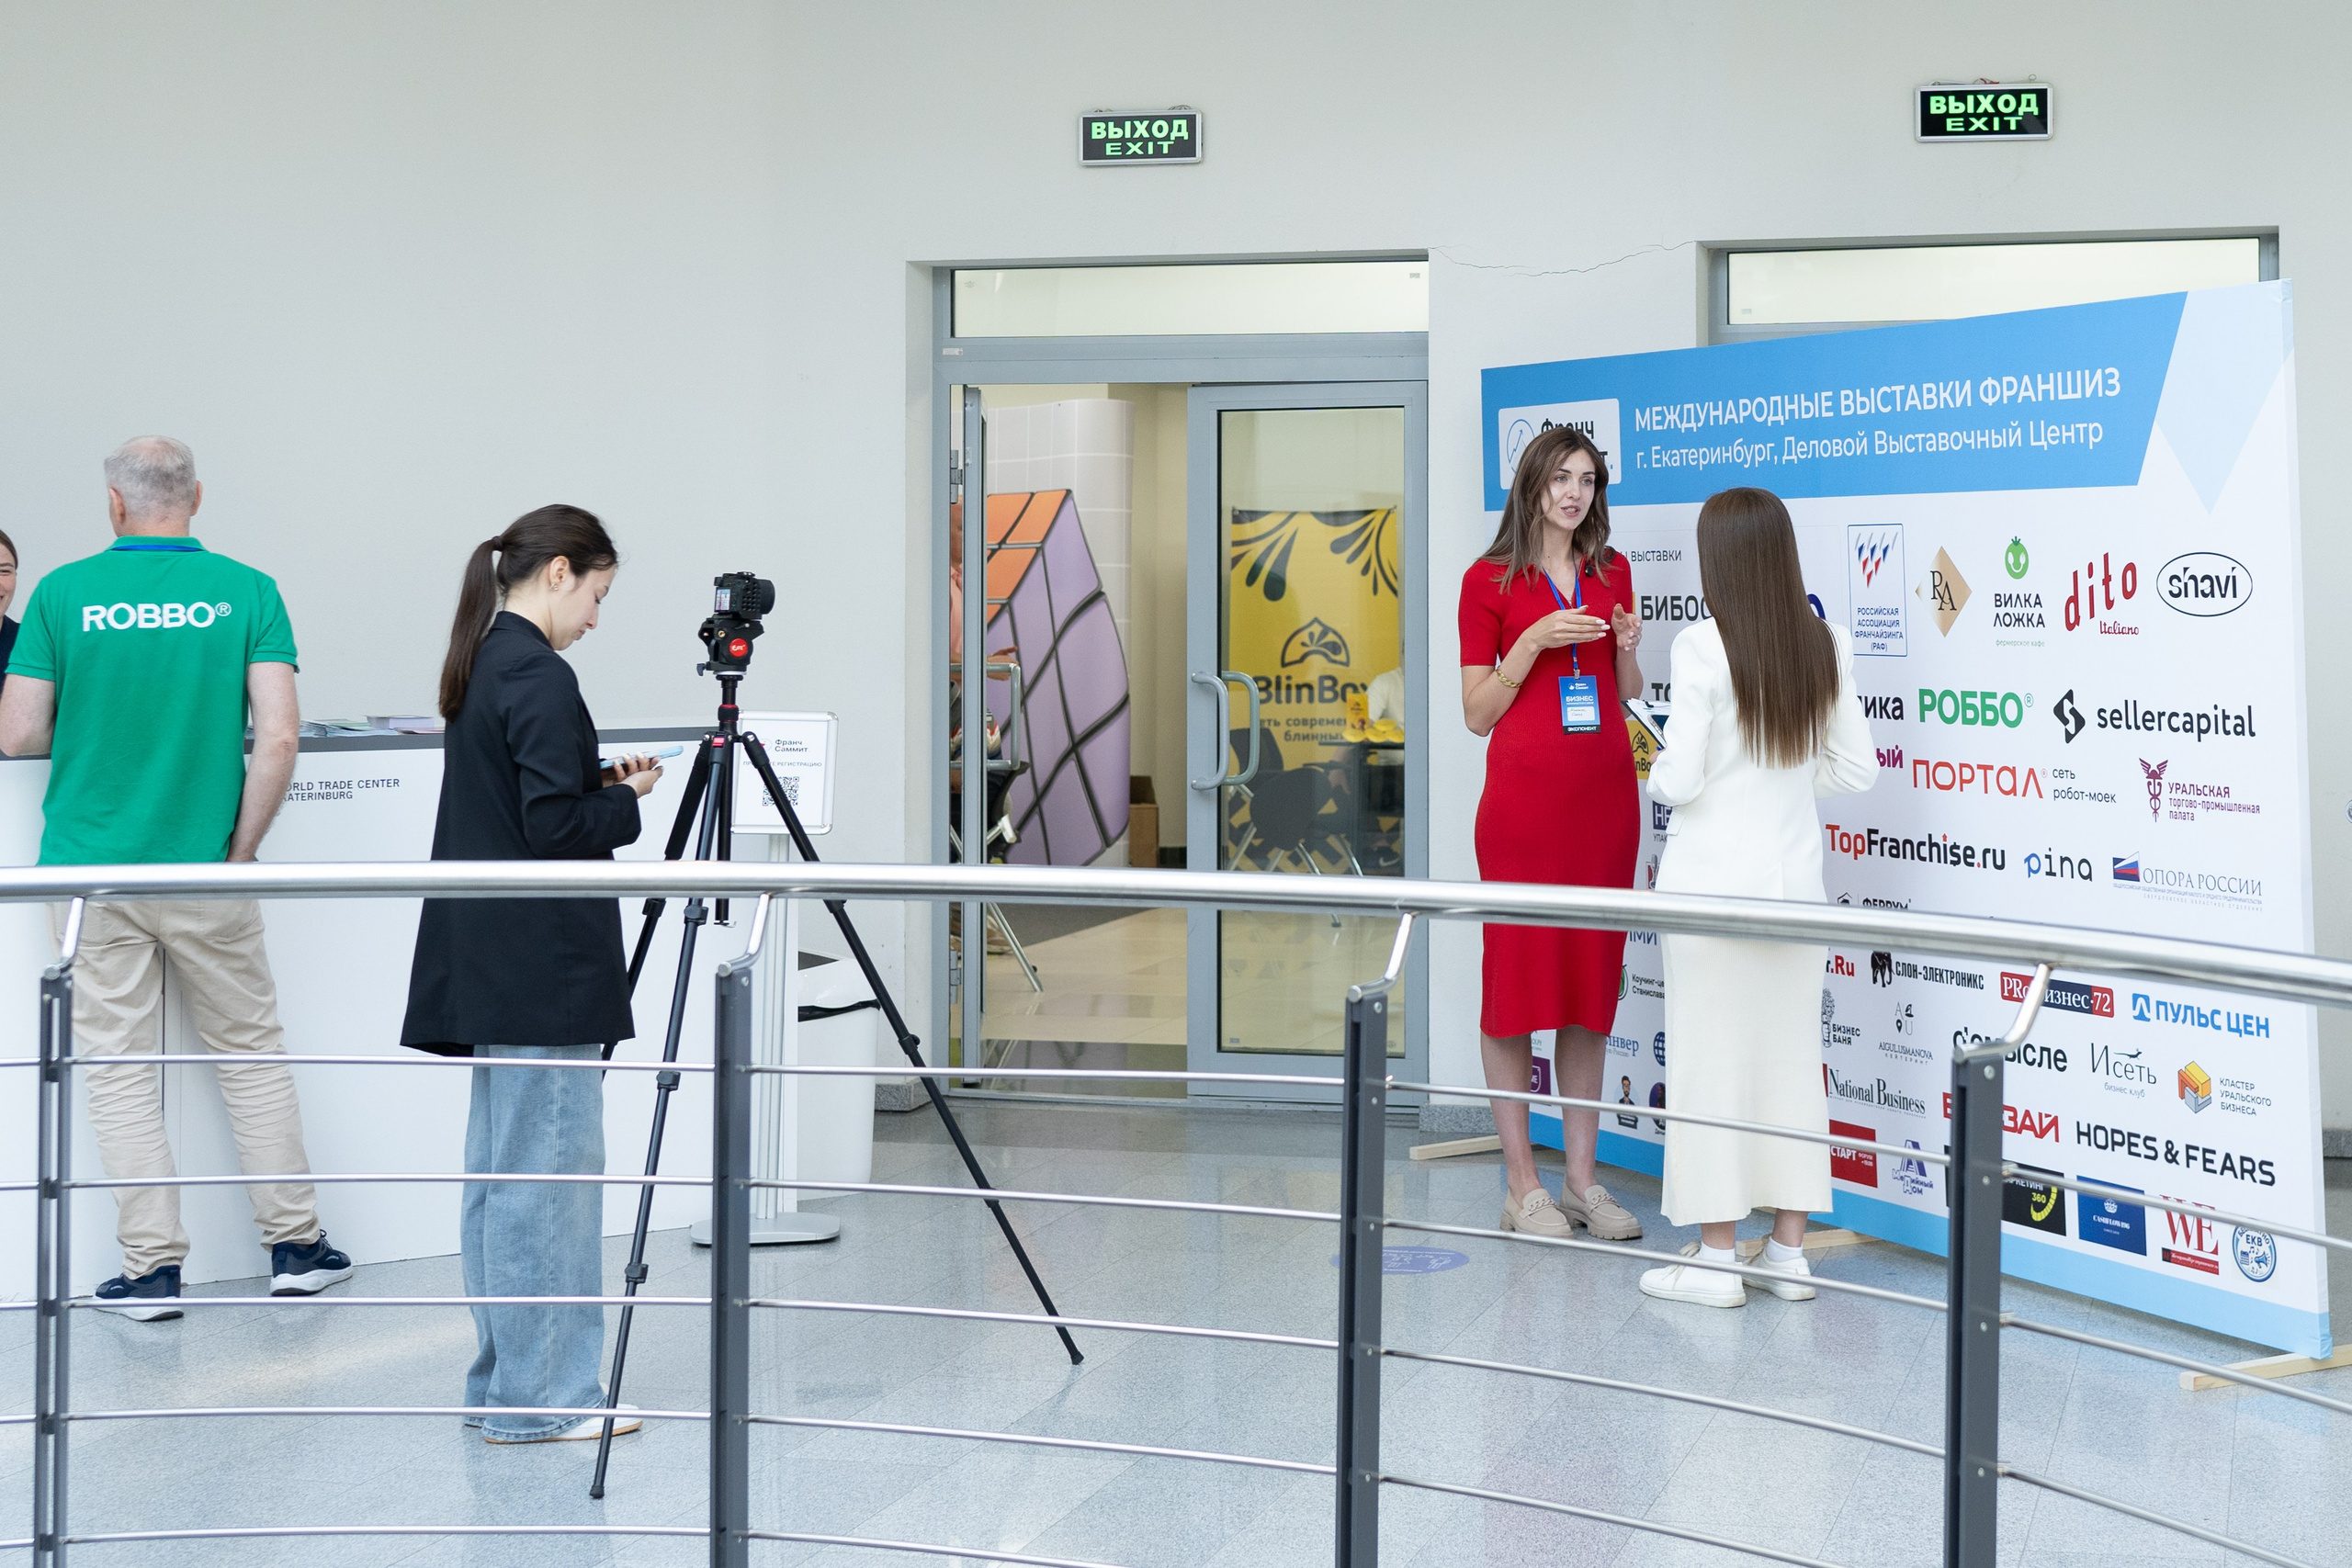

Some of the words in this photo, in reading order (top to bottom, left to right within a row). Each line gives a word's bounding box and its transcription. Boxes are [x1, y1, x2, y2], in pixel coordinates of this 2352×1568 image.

[1929, 93, 2039, 116] ВЫХОД
[1091, 118, 1189, 141] ВЫХОД
[1946, 117, 2023, 131] EXIT
[1105, 141, 1175, 156] EXIT
[1634, 390, 1834, 434] МЕЖДУНАРОДНЫЕ
[1840, 379, 1973, 417] ВЫСТАВКИ
[1979, 367, 2121, 408] ФРАНШИЗ
[1636, 452, 1645, 469] г.
[1652, 439, 1779, 472] Екатеринбург,
[1782, 430, 1869, 465] Деловой
[1874, 420, 2022, 457] Выставочный
[2029, 417, 2104, 451] Центр
[1631, 549, 1682, 563] выставки
[2168, 566, 2237, 599] shavi
[2064, 551, 2138, 632] dito
[1994, 592, 2043, 608] ВИЛКА
[1857, 605, 1899, 616] РОССИЙСКАЯ
[1857, 618, 1900, 628] АССОЦИАЦИЯ
[1993, 612, 2046, 628] ЛОЖКА
[2099, 620, 2140, 636] Italiano
[1854, 629, 1904, 640] ФРАНЧАЙЗИНГА
[1871, 642, 1888, 653] (РАФ)
[1254, 674, 1369, 705] BlinBo
[1260, 718, 1281, 728] еть
[2097, 698, 2256, 743] sellercapital
[775, 739, 803, 747] Франч
[775, 745, 808, 753] Саммит
[2052, 768, 2075, 780] сеть
[286, 782, 314, 792] RLD
[318, 780, 354, 790] TRADE
[357, 779, 400, 789] CENTER
[2168, 782, 2231, 798] УРАЛЬСКАЯ
[283, 791, 353, 802] ATERINBURG
[2053, 786, 2117, 803] робот-моек
[2169, 796, 2260, 814] торгово-промышленная
[2169, 810, 2195, 821] палата
[2143, 867, 2195, 889] ОПОРА
[2198, 873, 2263, 897] РОССИИ
[1895, 960, 1984, 990] СЛОН-ЭЛЕКТРОНИКС
[2155, 999, 2222, 1032] ПУЛЬС
[2226, 1010, 2270, 1039] ЦЕН
[1832, 1023, 1861, 1037] БИЗНЕС
[1832, 1034, 1852, 1046] БАНЯ
[2090, 1042, 2157, 1085] Исеть
[1828, 1067, 1874, 1103] National
[1876, 1077, 1926, 1115] Business
[2104, 1081, 2128, 1095] бизнес
[2130, 1086, 2145, 1099] клуб
[2219, 1077, 2256, 1091] КЛАСТЕР
[2220, 1089, 2272, 1107] УРАЛЬСКОГО
[2221, 1102, 2256, 1116] БИЗНЕСА
[1830, 1145, 1857, 1161] СТАРТ
[2076, 1121, 2158, 1161] HOPES
[2164, 1140, 2180, 1165] &
[2186, 1144, 2276, 1187] FEARS
[2031, 1191, 2047, 1204] 360
[2159, 1193, 2219, 1256] WE
